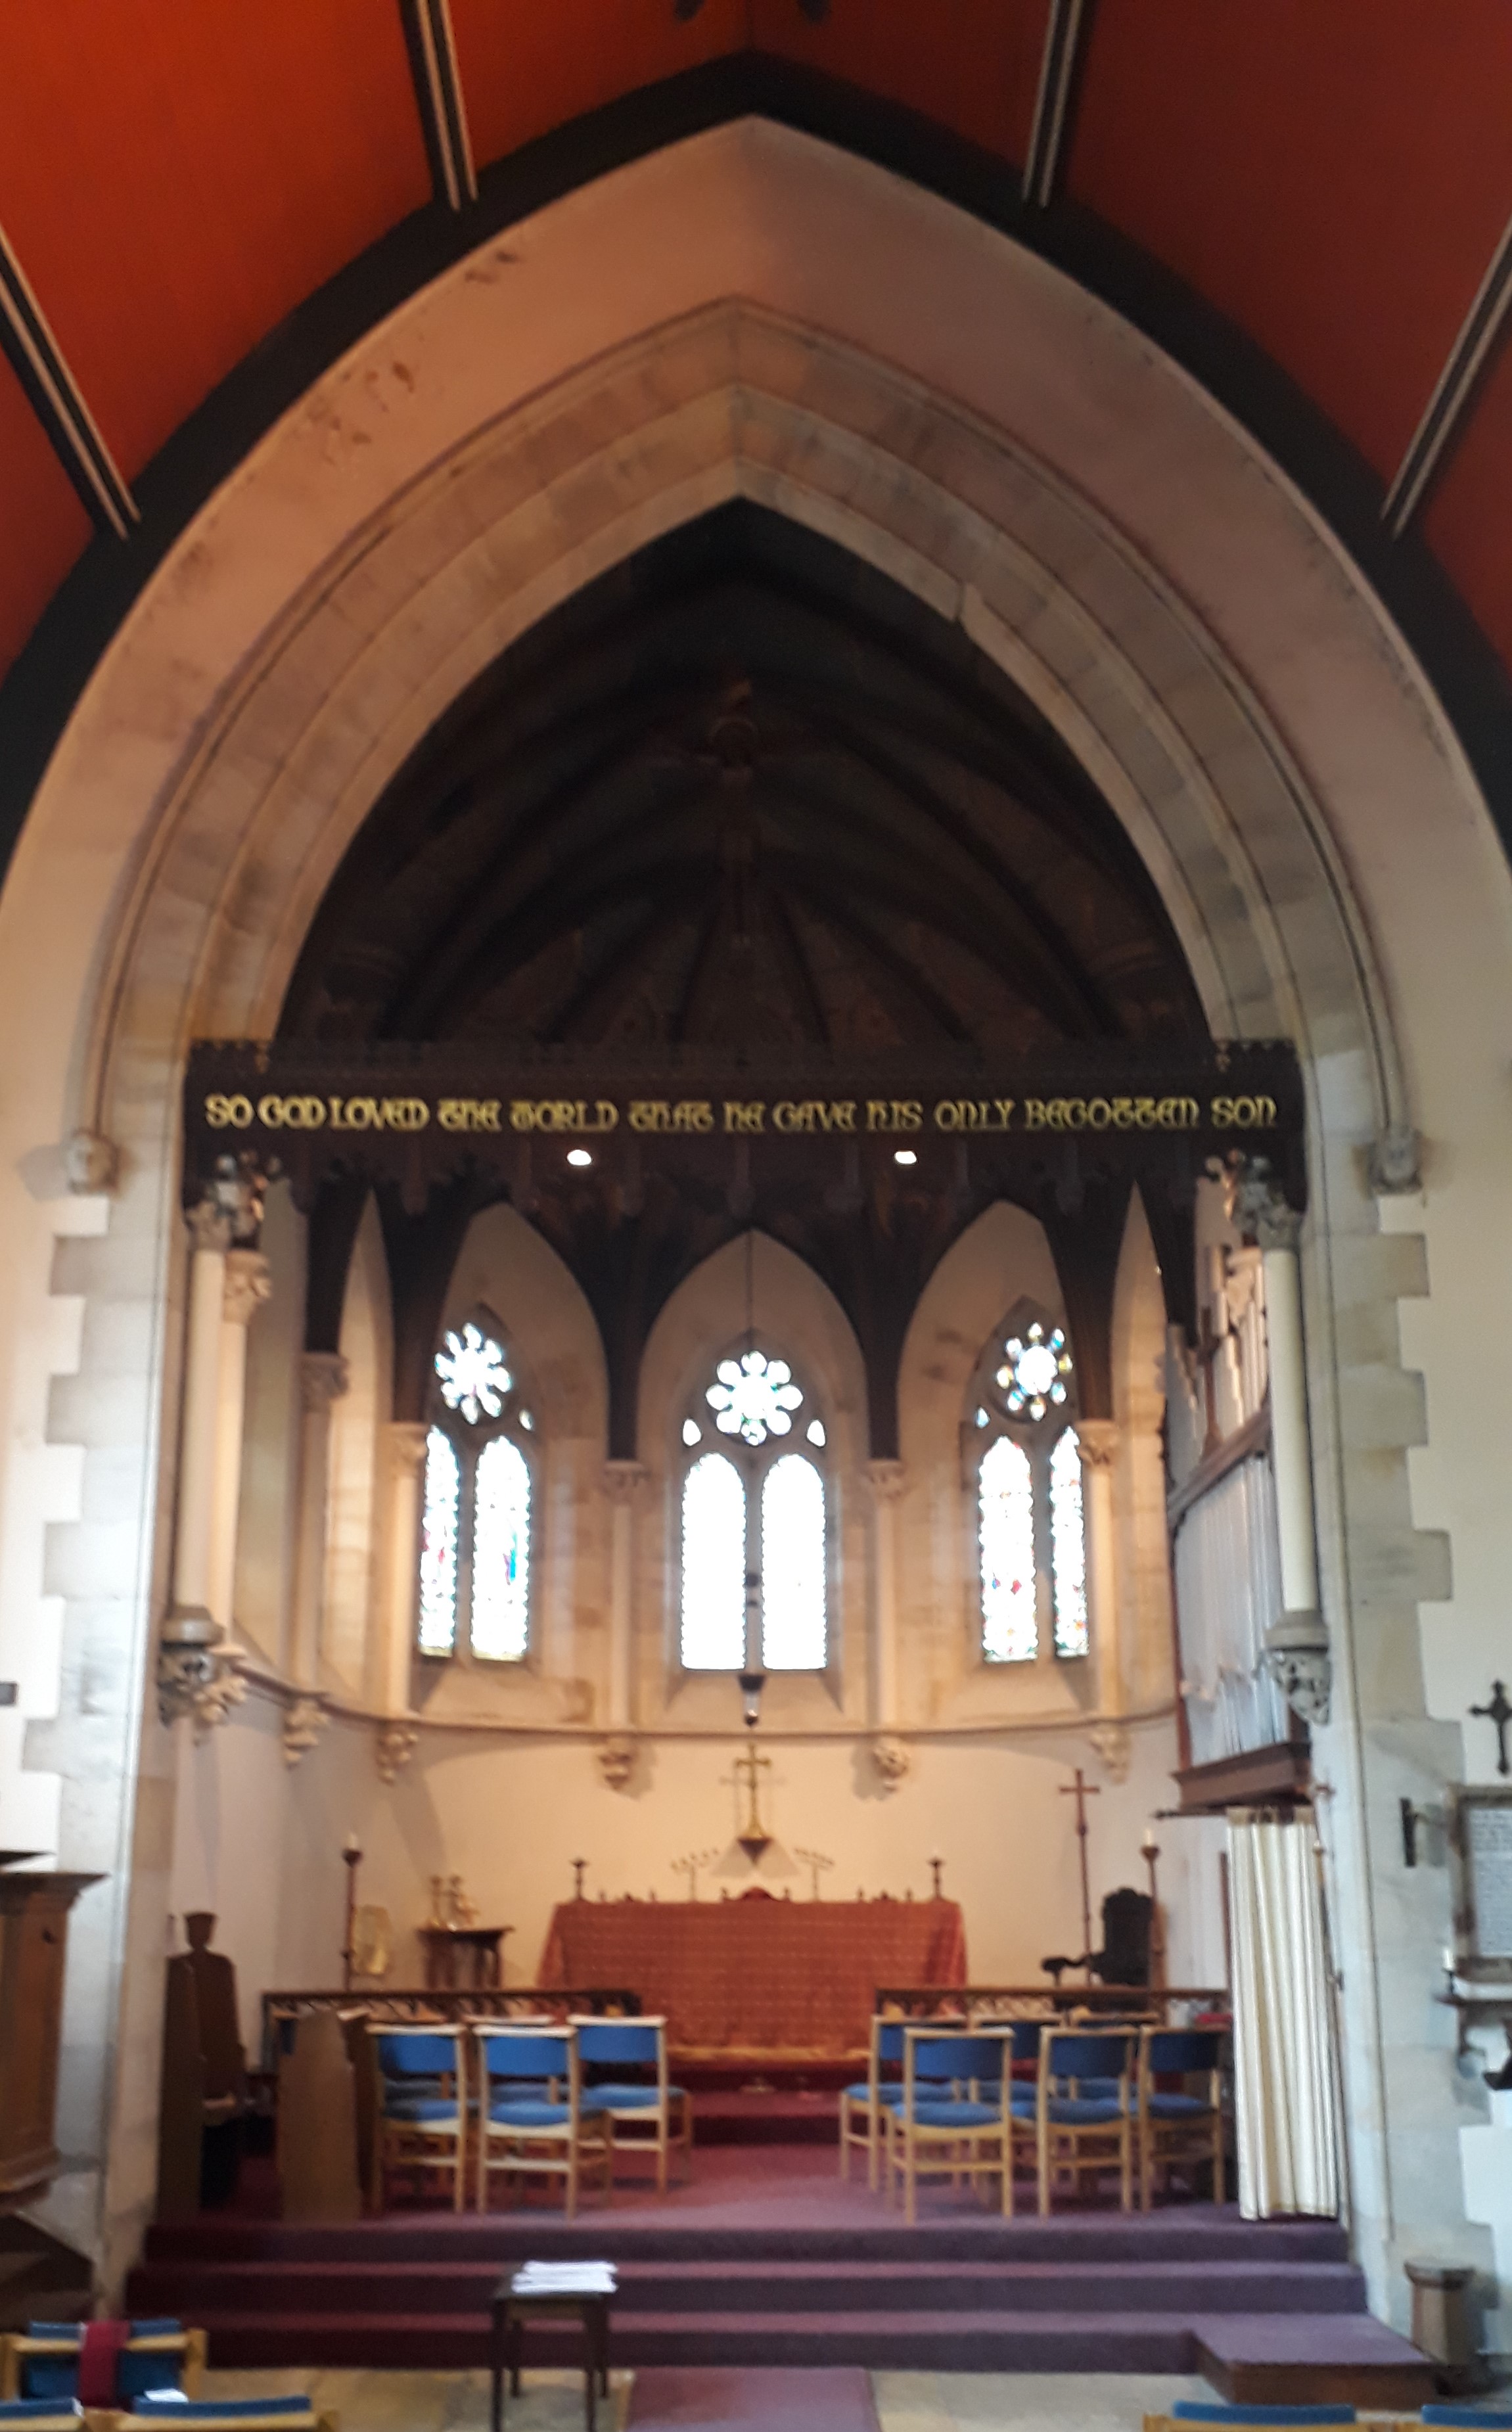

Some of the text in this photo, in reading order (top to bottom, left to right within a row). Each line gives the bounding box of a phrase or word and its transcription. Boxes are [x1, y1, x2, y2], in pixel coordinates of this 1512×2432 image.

[205, 1093, 1276, 1132] SO GOD LOVED THE WORLD THAT HE GAVE HIS ONLY BEGOTTEN SON
